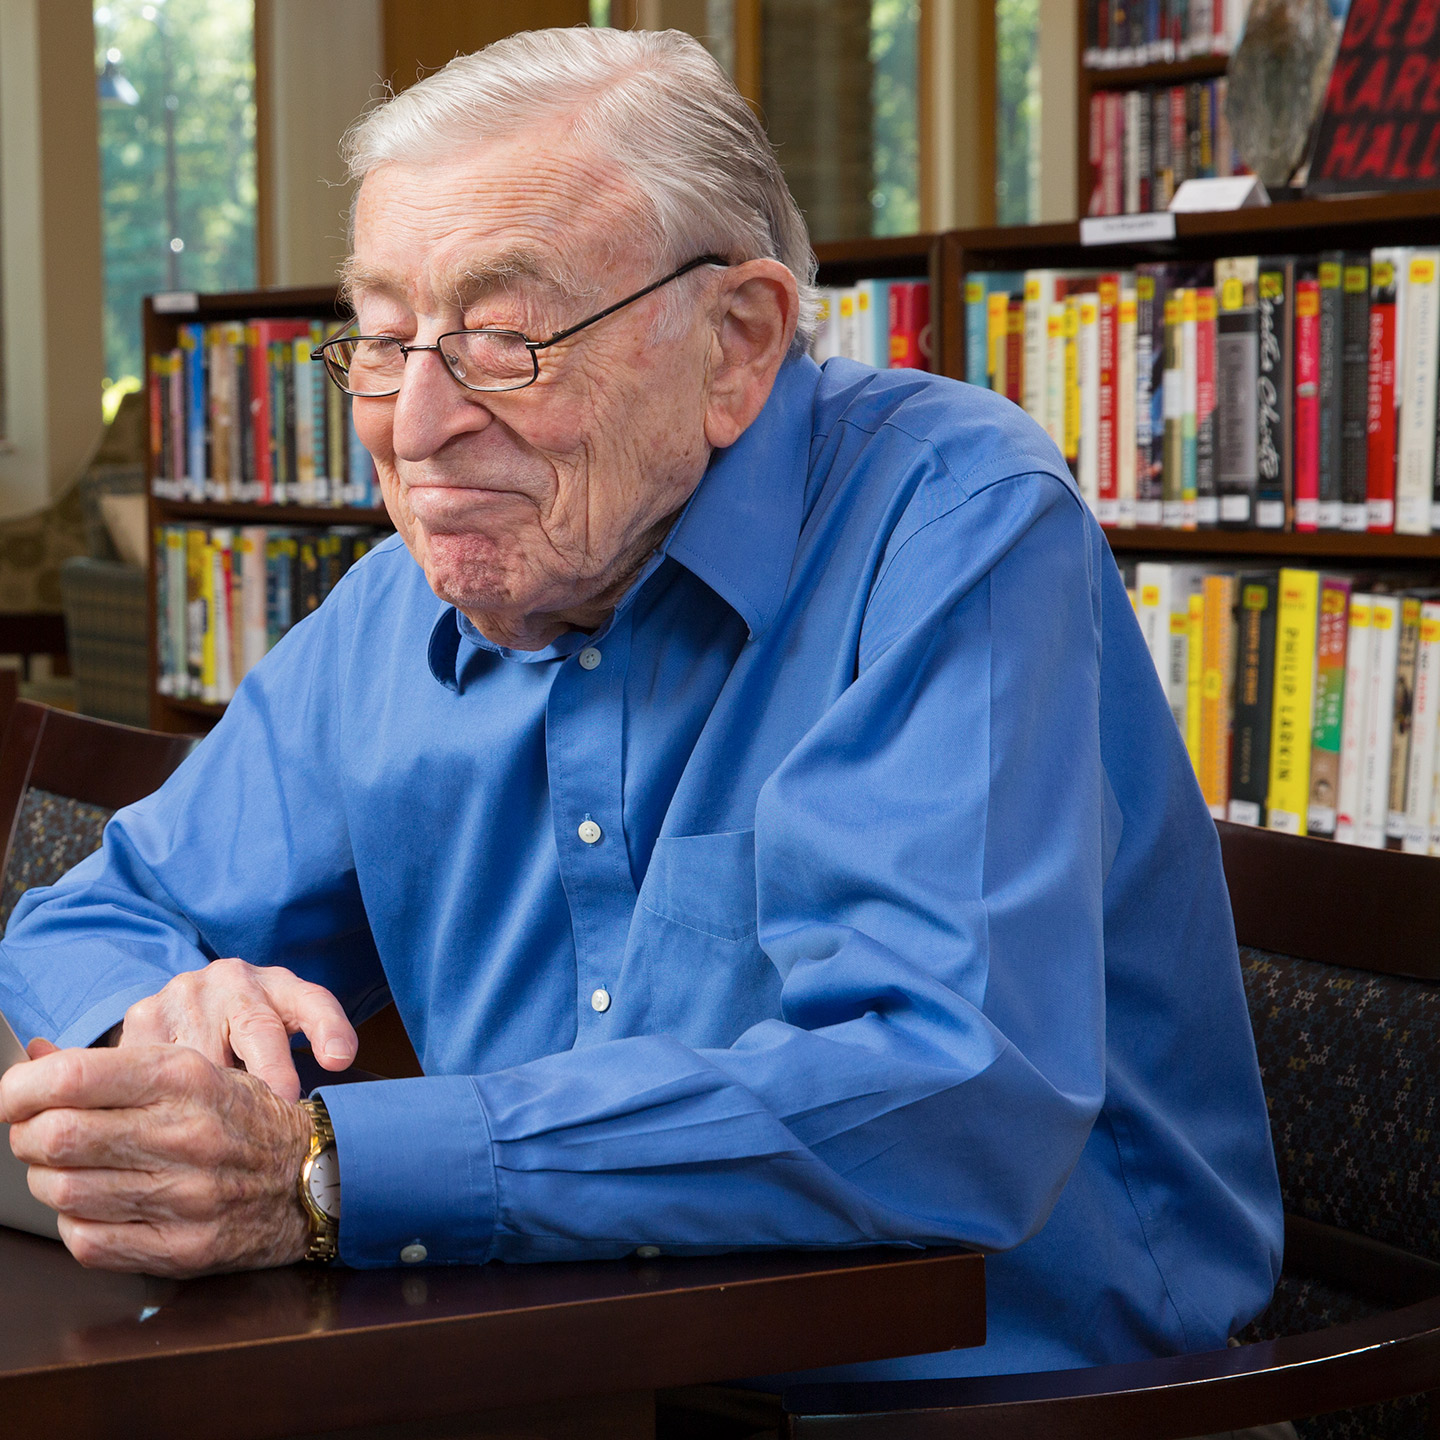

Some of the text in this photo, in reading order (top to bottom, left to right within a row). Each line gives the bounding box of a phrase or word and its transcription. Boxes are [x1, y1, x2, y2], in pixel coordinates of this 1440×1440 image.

[1368, 312, 1384, 434] BROTHERS
[1383, 359, 1394, 385] THE
[1281, 627, 1300, 697] PHILIP
[1314, 673, 1329, 739] FAMILY
[1326, 693, 1340, 726] THE
[1277, 704, 1297, 782] LARKIN
